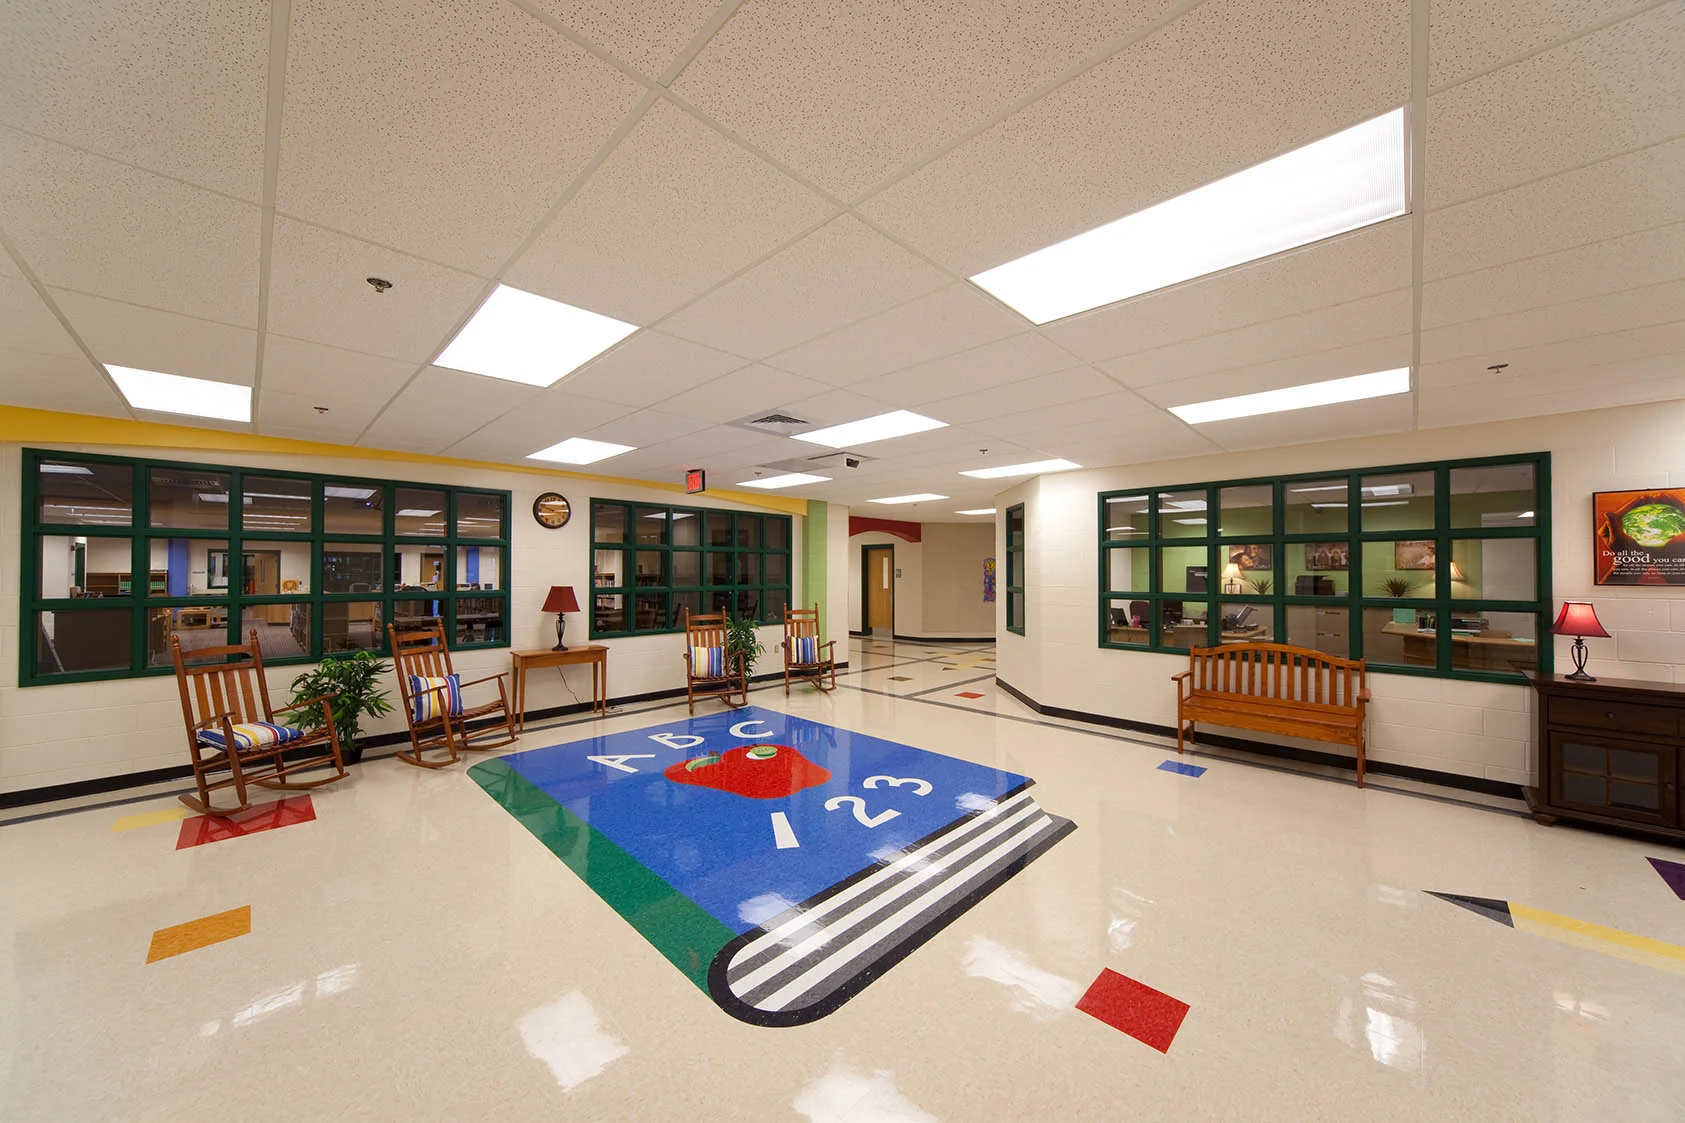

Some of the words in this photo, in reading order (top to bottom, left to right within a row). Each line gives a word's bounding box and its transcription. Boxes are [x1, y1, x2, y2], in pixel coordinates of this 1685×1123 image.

[1613, 554, 1650, 565] good
[586, 753, 656, 774] A
[648, 732, 705, 749] B
[729, 720, 774, 738] C
[771, 811, 800, 850] 1
[824, 795, 902, 828] 2
[863, 775, 934, 796] 3
